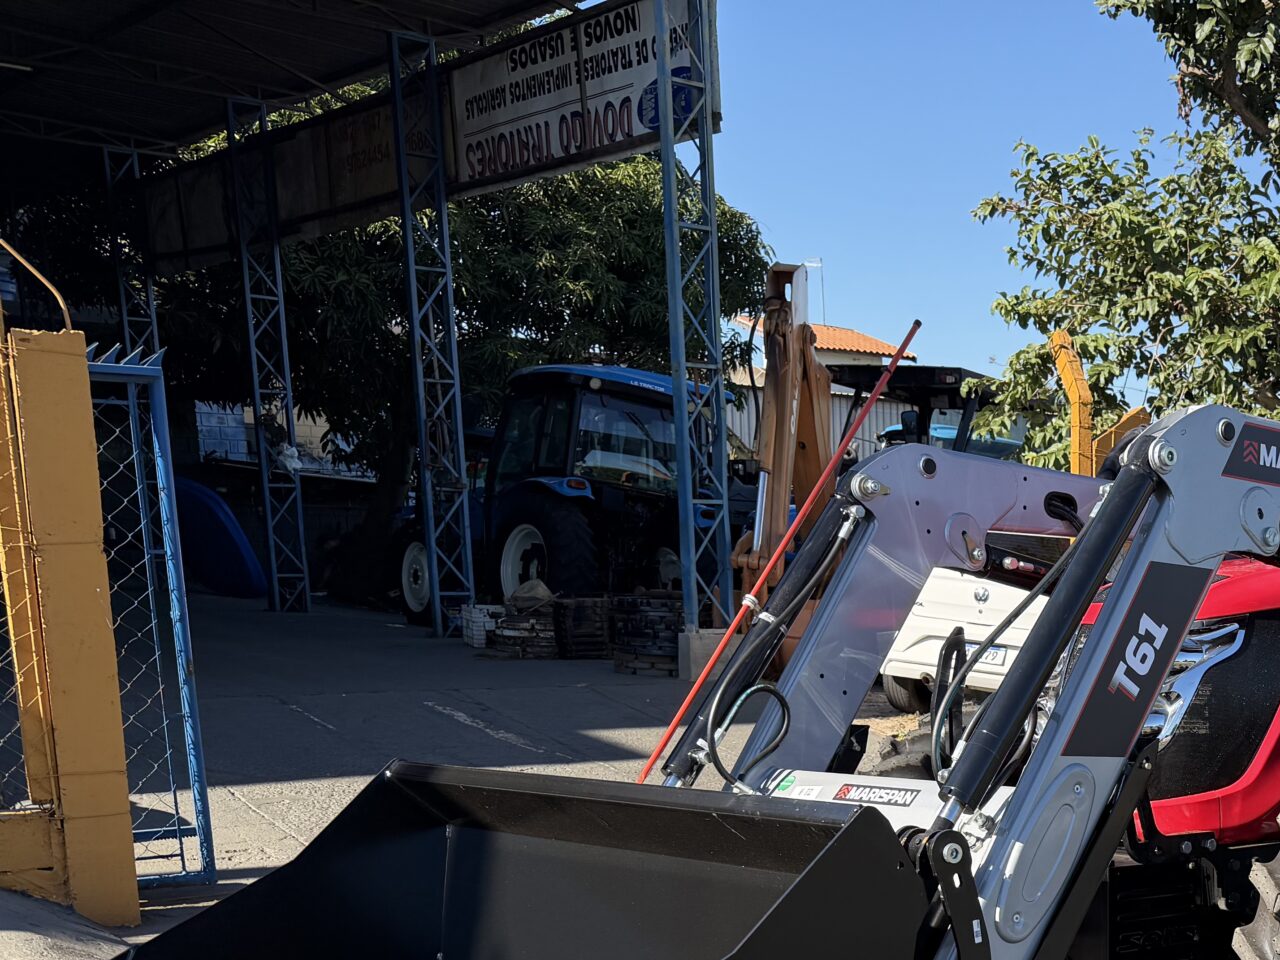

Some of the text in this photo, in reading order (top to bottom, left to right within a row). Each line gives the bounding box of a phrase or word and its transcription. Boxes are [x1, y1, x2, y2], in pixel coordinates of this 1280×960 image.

[584, 42, 634, 83] TRATORES
[637, 35, 652, 66] DE
[509, 60, 573, 106] IMPLEMENTOS
[465, 95, 634, 180] DOVIGO TRATORES
[1107, 612, 1169, 701] T61
[845, 785, 918, 806] MARISPAN
